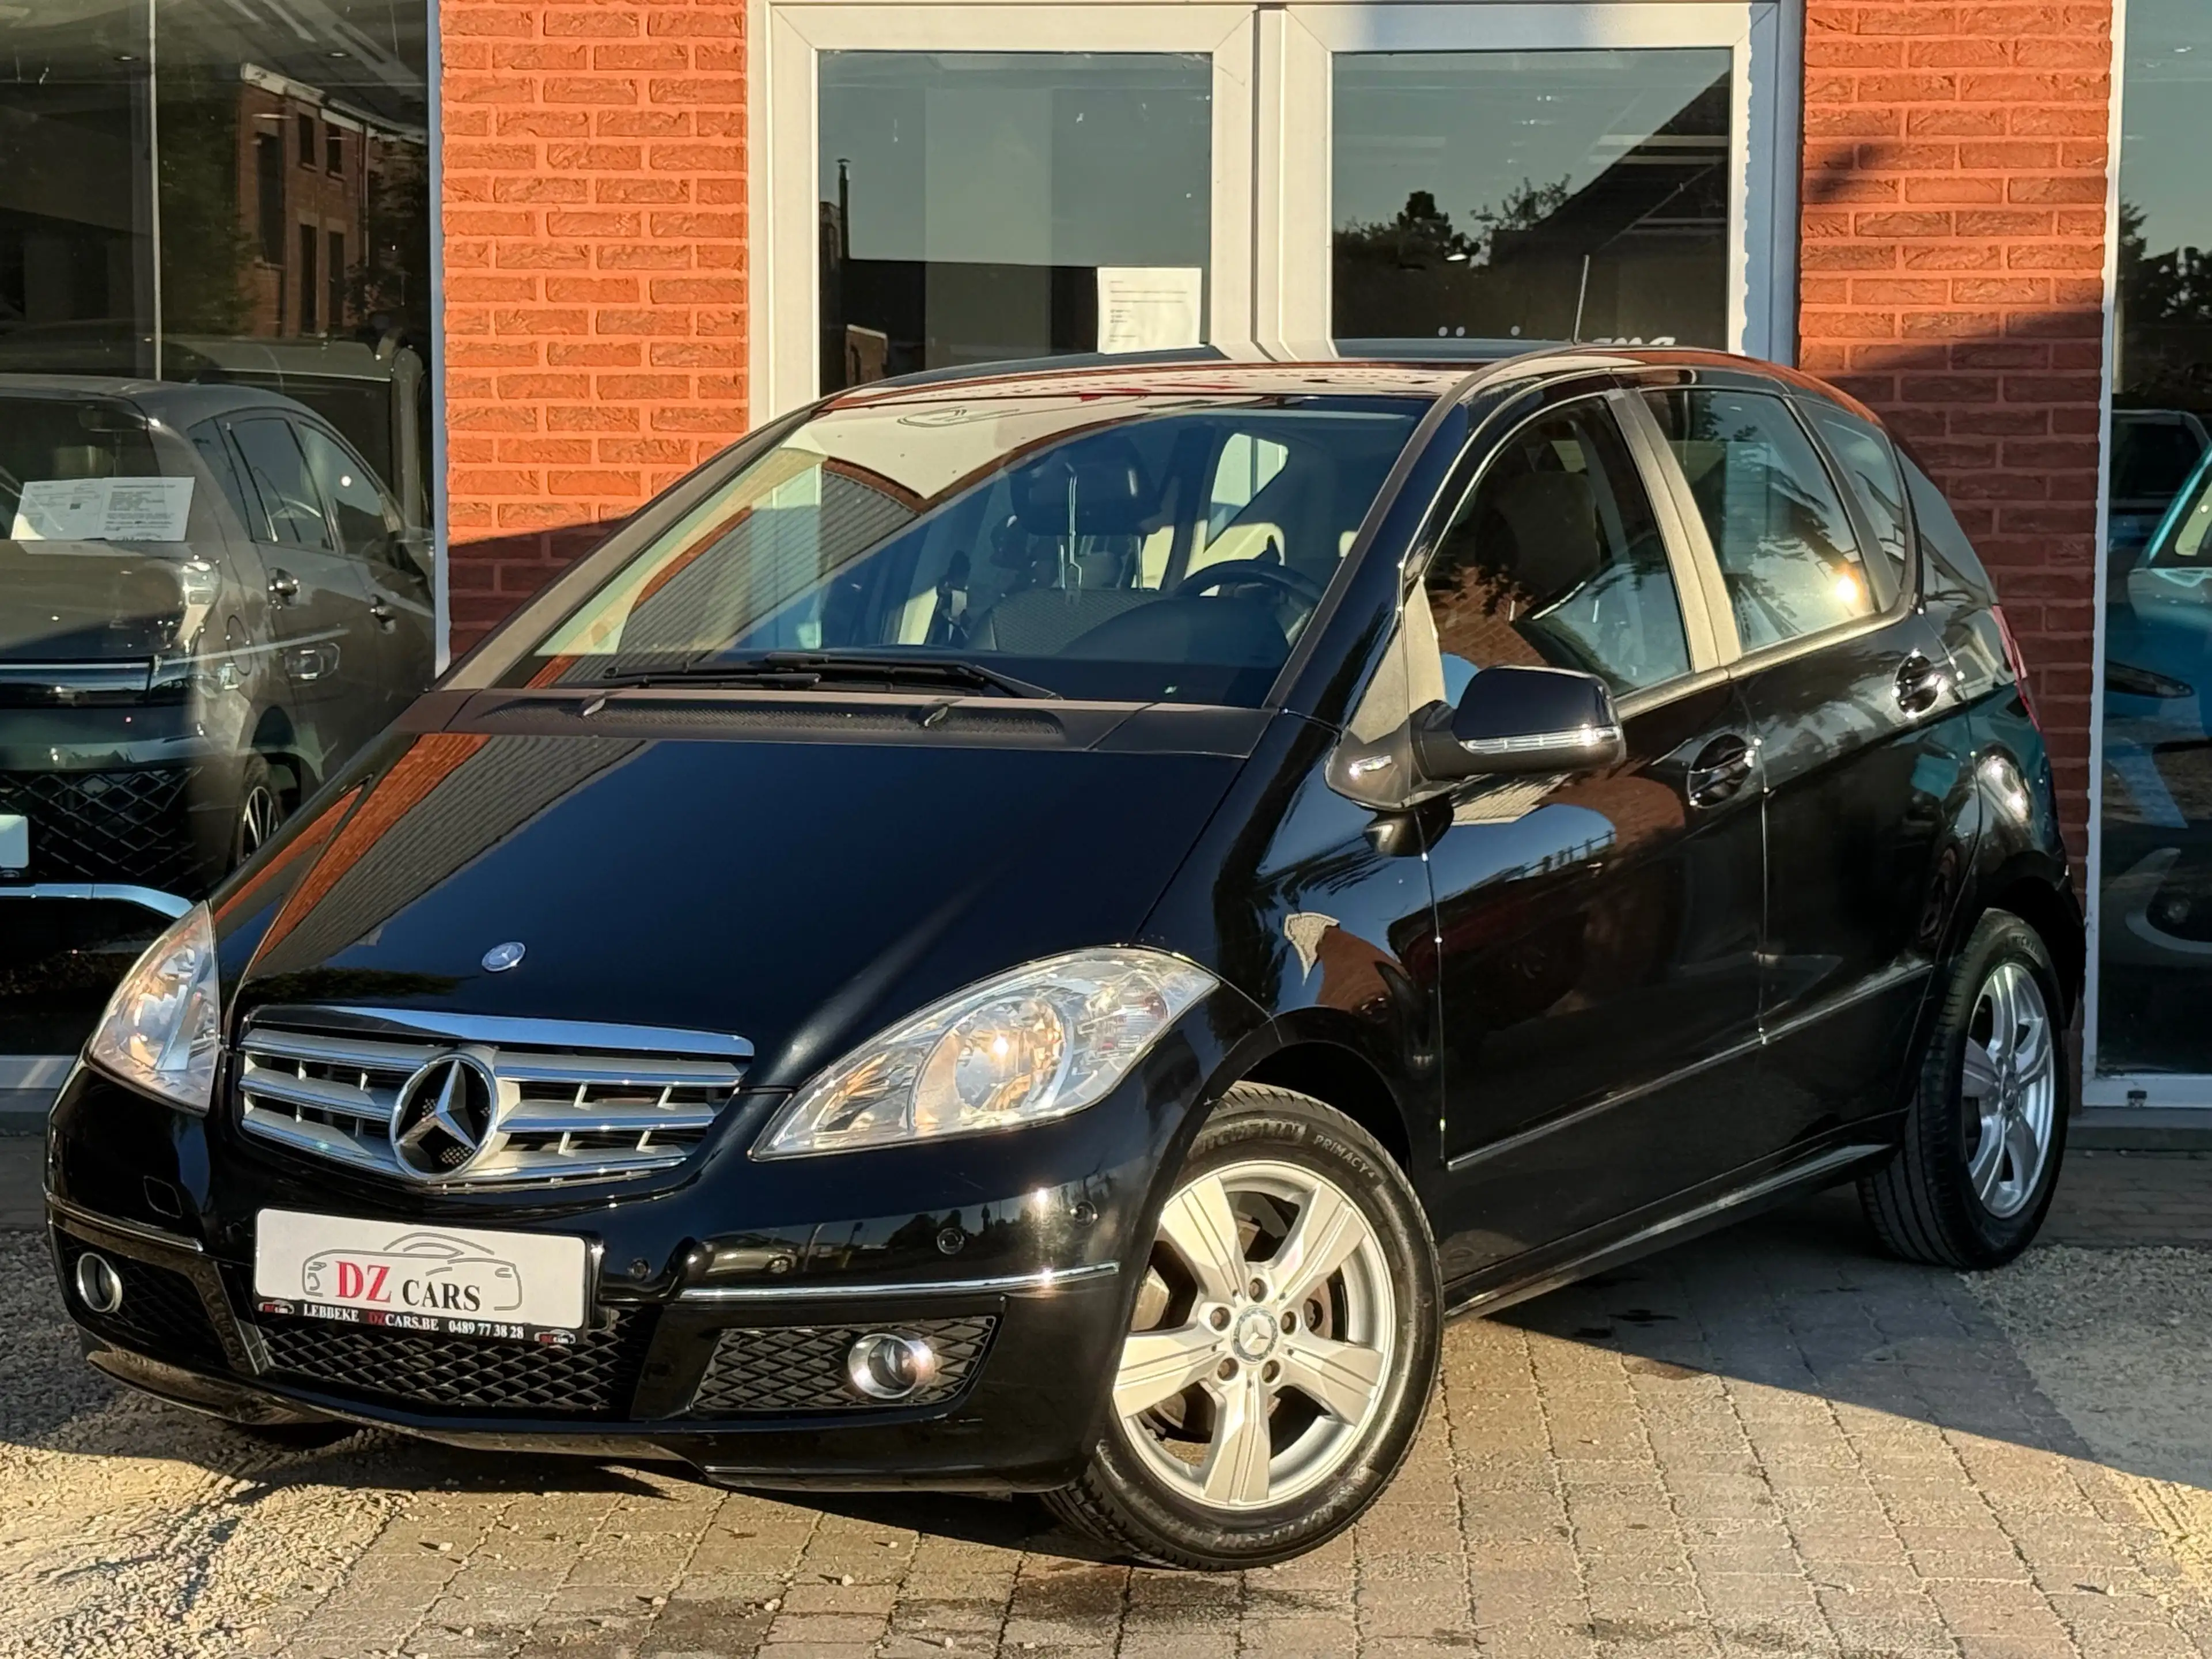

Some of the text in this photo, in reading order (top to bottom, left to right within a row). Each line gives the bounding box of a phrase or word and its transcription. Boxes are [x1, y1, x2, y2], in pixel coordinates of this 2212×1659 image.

[1313, 1134, 1369, 1173] PRIMACY
[335, 1260, 480, 1312] DZ CARS
[448, 1320, 475, 1335] 0489
[479, 1323, 491, 1336] 77
[493, 1324, 508, 1338] 38
[510, 1326, 524, 1339] 28
